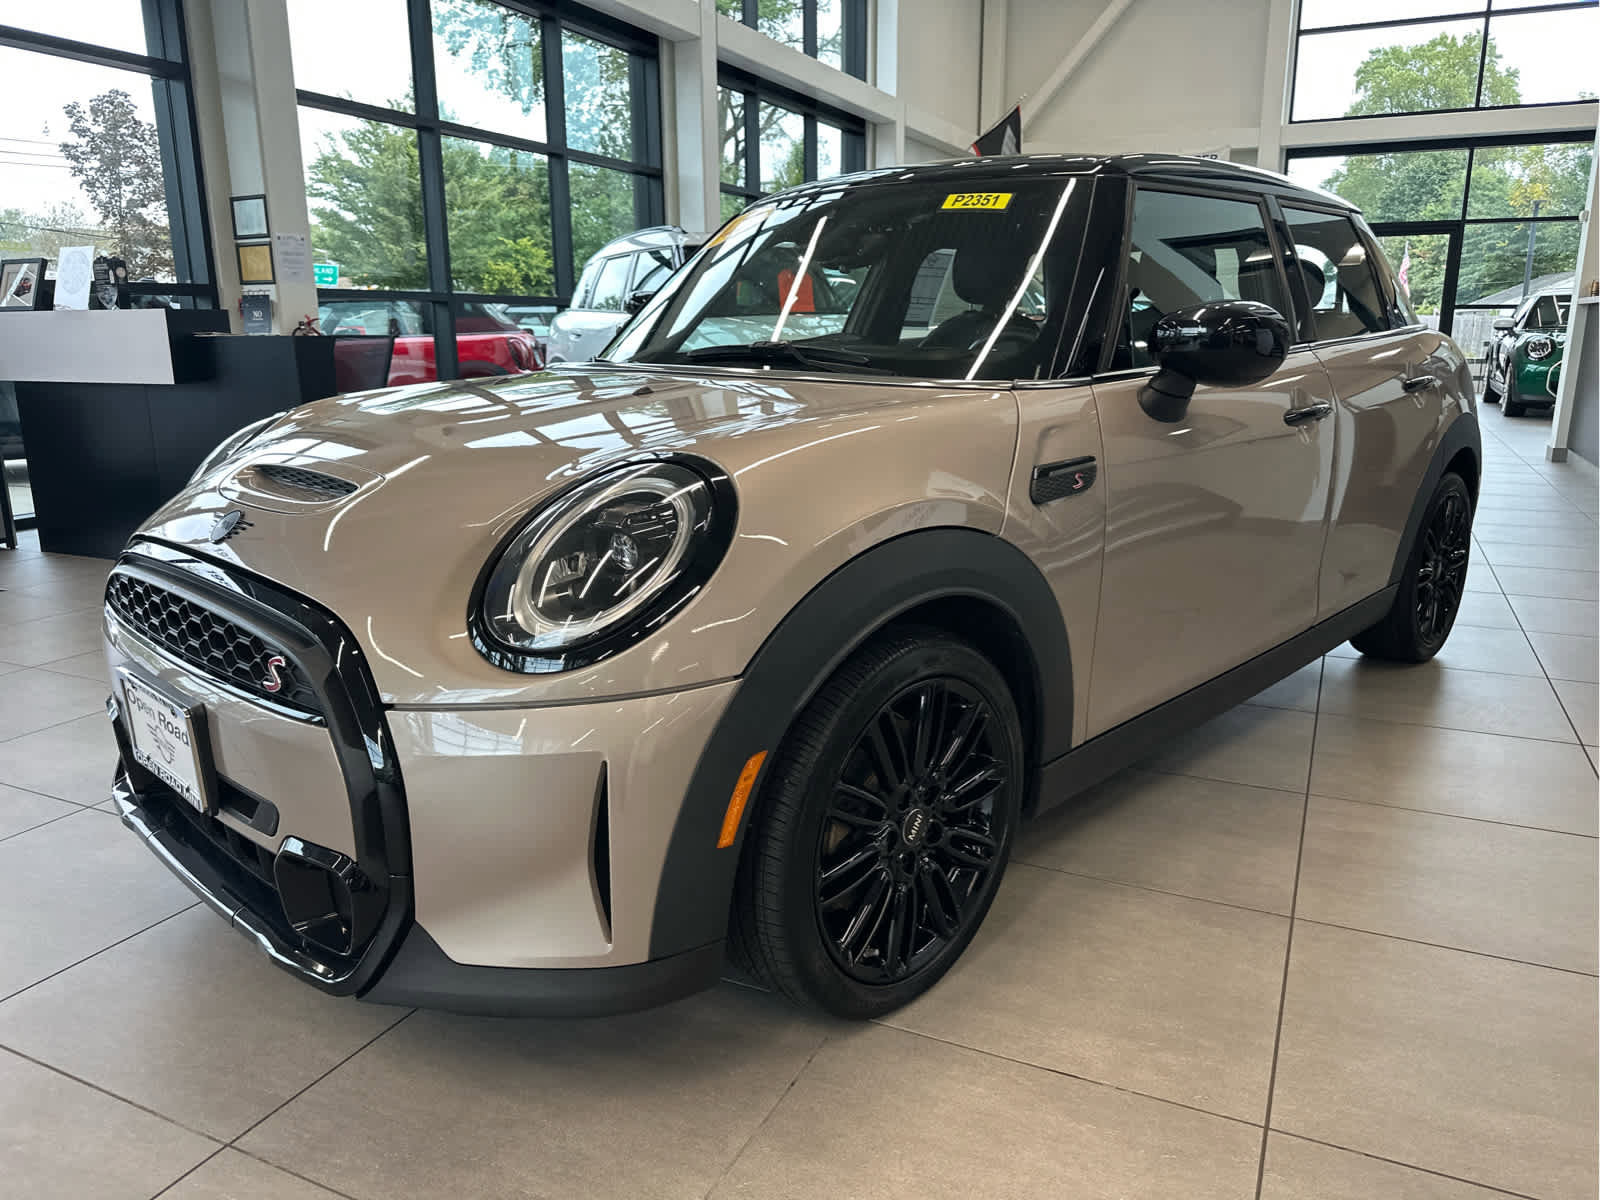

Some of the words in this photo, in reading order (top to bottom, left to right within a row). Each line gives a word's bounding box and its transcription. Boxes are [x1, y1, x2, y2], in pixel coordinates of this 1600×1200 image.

[951, 194, 1001, 207] P2351
[1072, 472, 1084, 489] S
[262, 655, 286, 692] S
[127, 688, 157, 719] Open
[158, 712, 190, 746] Road
[908, 814, 922, 841] MINI
